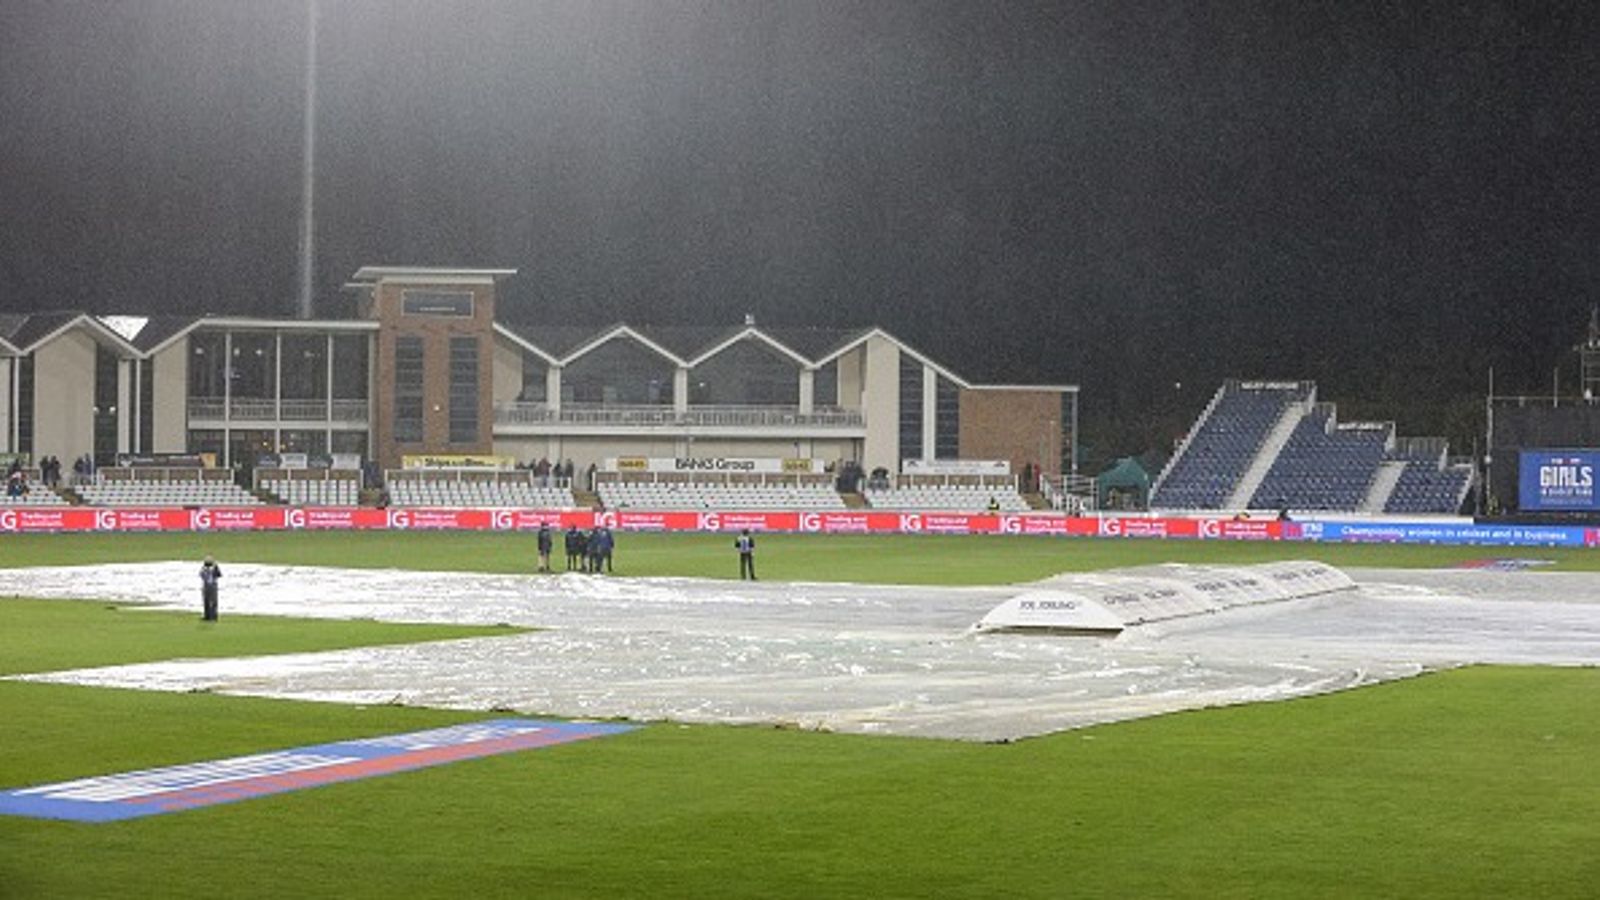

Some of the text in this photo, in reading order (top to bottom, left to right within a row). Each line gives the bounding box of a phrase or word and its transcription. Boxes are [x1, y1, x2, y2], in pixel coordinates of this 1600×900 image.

[675, 458, 755, 471] BANKS Group
[1540, 466, 1593, 487] GIRLS
[0, 511, 16, 529] G
[95, 511, 116, 529] IG
[190, 510, 211, 530] IG
[285, 509, 305, 527] IG
[387, 510, 409, 528] IG
[492, 511, 513, 528] IG
[594, 512, 617, 528] IG
[697, 513, 720, 530] IG
[800, 513, 821, 530] IG
[900, 514, 922, 531] IG
[1000, 516, 1021, 534] IG
[1100, 517, 1120, 535] IG
[1198, 520, 1220, 538] IG
[1408, 529, 1442, 538] women
[1446, 529, 1455, 537] in
[1492, 529, 1511, 538] and
[1514, 529, 1522, 538] in
